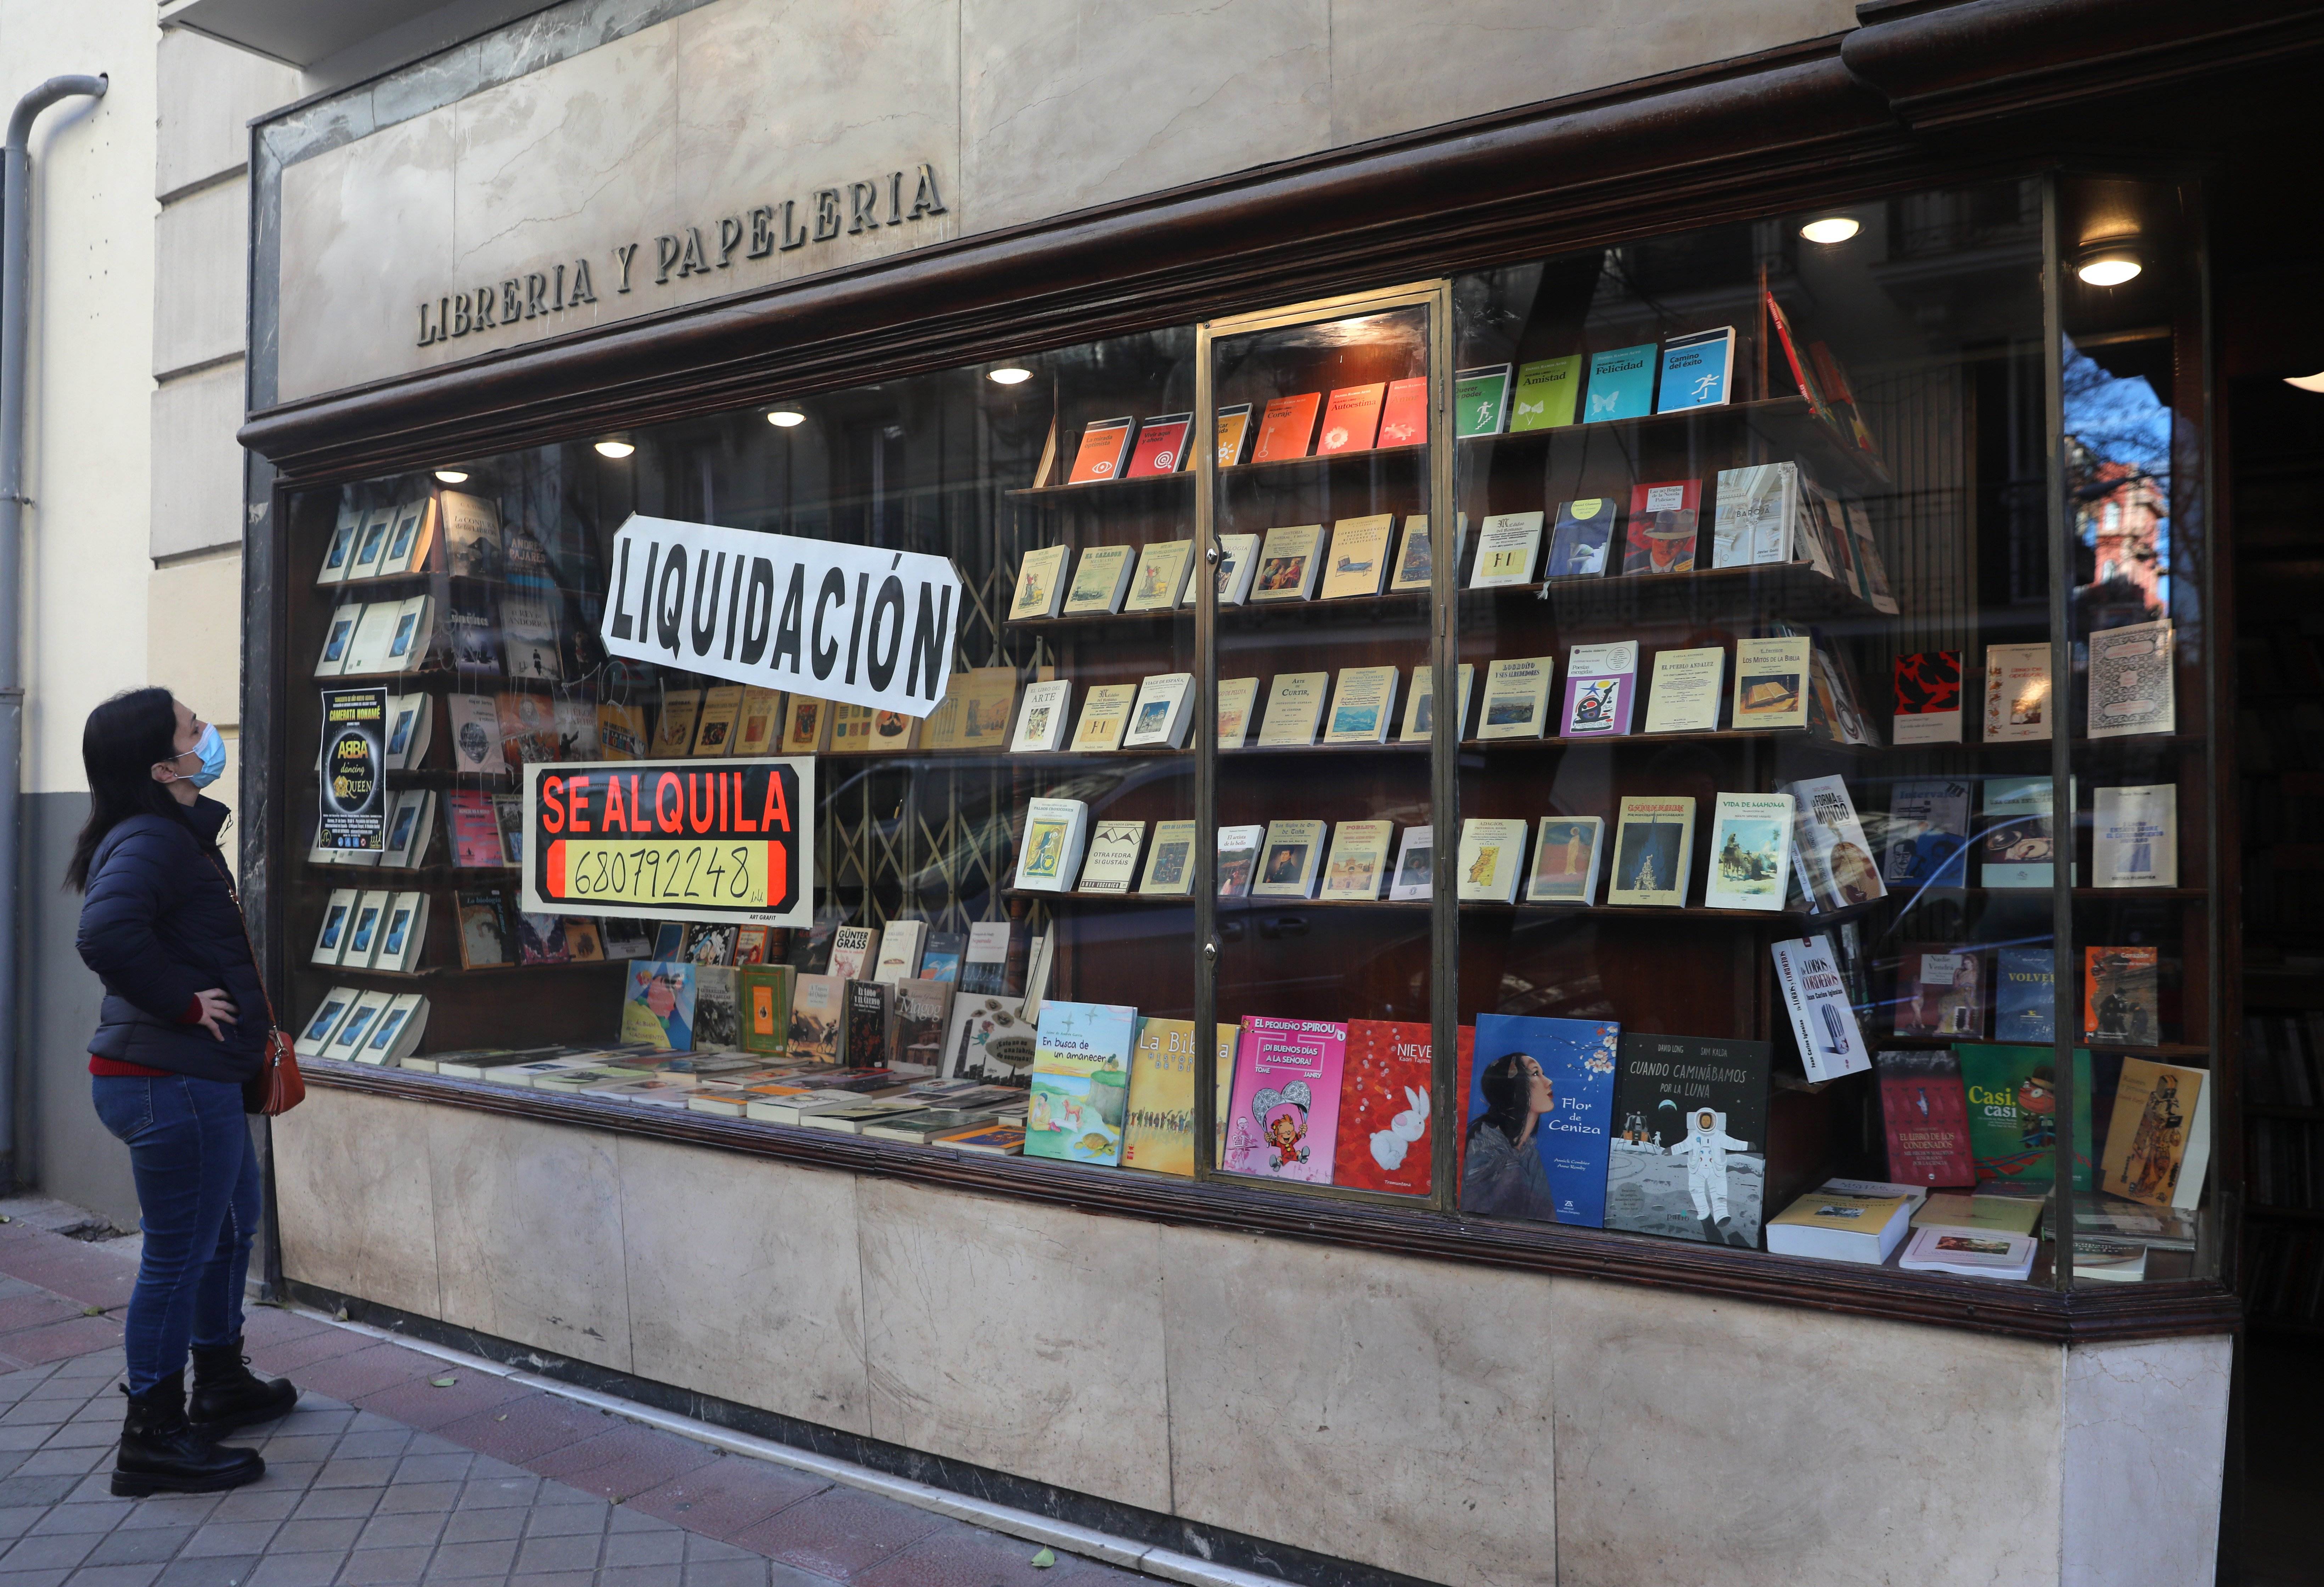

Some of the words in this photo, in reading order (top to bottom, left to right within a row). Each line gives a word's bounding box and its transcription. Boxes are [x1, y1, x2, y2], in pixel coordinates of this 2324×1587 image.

[416, 258, 597, 347] LIBRERIA
[612, 242, 637, 294] Y
[654, 163, 947, 283] PAPELERIA
[1669, 362, 1681, 370] del
[1683, 359, 1703, 367] éxito
[1670, 354, 1699, 363] Camino
[1596, 360, 1643, 375] Felicidad
[1523, 371, 1566, 386] Amistad
[1390, 395, 1419, 404] Amor
[1461, 390, 1482, 400] poder
[1331, 399, 1376, 411] Autoestima
[1267, 410, 1292, 419] Coraje
[1085, 440, 1110, 448] optimista
[1737, 505, 1770, 518] BAROJA
[1338, 527, 1386, 536] CORRESPONDENCIA
[610, 537, 952, 701] LIQUIDACIÓN
[1502, 662, 1535, 671] LOGROÑO
[1508, 669, 1540, 677] ALREDEDORES
[1031, 693, 1056, 702] ARTE
[329, 708, 355, 722] CAMERATA
[357, 705, 380, 721] NONAMÉ
[337, 740, 368, 759] ABBA
[341, 762, 365, 776] dancing
[346, 780, 372, 798] QUEEN
[542, 775, 590, 834] SE
[602, 771, 791, 835] ALQUILA
[1814, 792, 1838, 807] FORMA
[1813, 803, 1850, 826] MUNDO
[575, 846, 749, 898] 680792248
[839, 927, 868, 939] GÜNTER
[837, 939, 866, 949] GRASS
[1779, 950, 1793, 982] CORDEROS
[1804, 957, 1828, 975] LOBOS
[1802, 971, 1839, 992] CORDEROS
[1789, 986, 1800, 1006] LOBOS
[1827, 989, 1843, 997] Iglesias
[863, 996, 880, 1005] CUERVO
[900, 996, 942, 1022] Magog
[1254, 1018, 1265, 1028] EL
[1265, 1020, 1300, 1031] PEQUEÑO
[1301, 1021, 1336, 1034] SPIROU
[1799, 1019, 1808, 1039] Iglesias
[1042, 1036, 1052, 1046] En
[1054, 1038, 1076, 1049] busca
[1139, 1028, 1160, 1051] La
[1263, 1044, 1273, 1054] ¡DI
[1273, 1044, 1300, 1054] BUENOS
[1301, 1044, 1318, 1056] DÍAS
[1397, 1044, 1432, 1058] NIEVE
[1658, 1044, 1672, 1052] DAVID
[1672, 1045, 1684, 1054] LONG
[1700, 1047, 1711, 1056] SAM
[1712, 1047, 1728, 1057] KALDA
[1066, 1052, 1106, 1063] amanecer
[1282, 1054, 1312, 1065] SEÑORA!
[1303, 1071, 1322, 1079] JANRY
[1630, 1061, 1669, 1078] CUANDO
[1673, 1063, 1748, 1084] CAMINÁBAMOS
[1660, 1083, 1672, 1093] POR
[1673, 1084, 1681, 1094] LA
[1684, 1082, 1710, 1099] LUNA
[1968, 1086, 2016, 1107] Casi,
[1561, 1097, 1592, 1111] Flor
[1569, 1112, 1582, 1121] de
[1984, 1105, 2017, 1118] casi
[1548, 1119, 1601, 1135] Ceniza
[1903, 1141, 1953, 1149] CONDENADOS
[1666, 1212, 1690, 1223] patio
